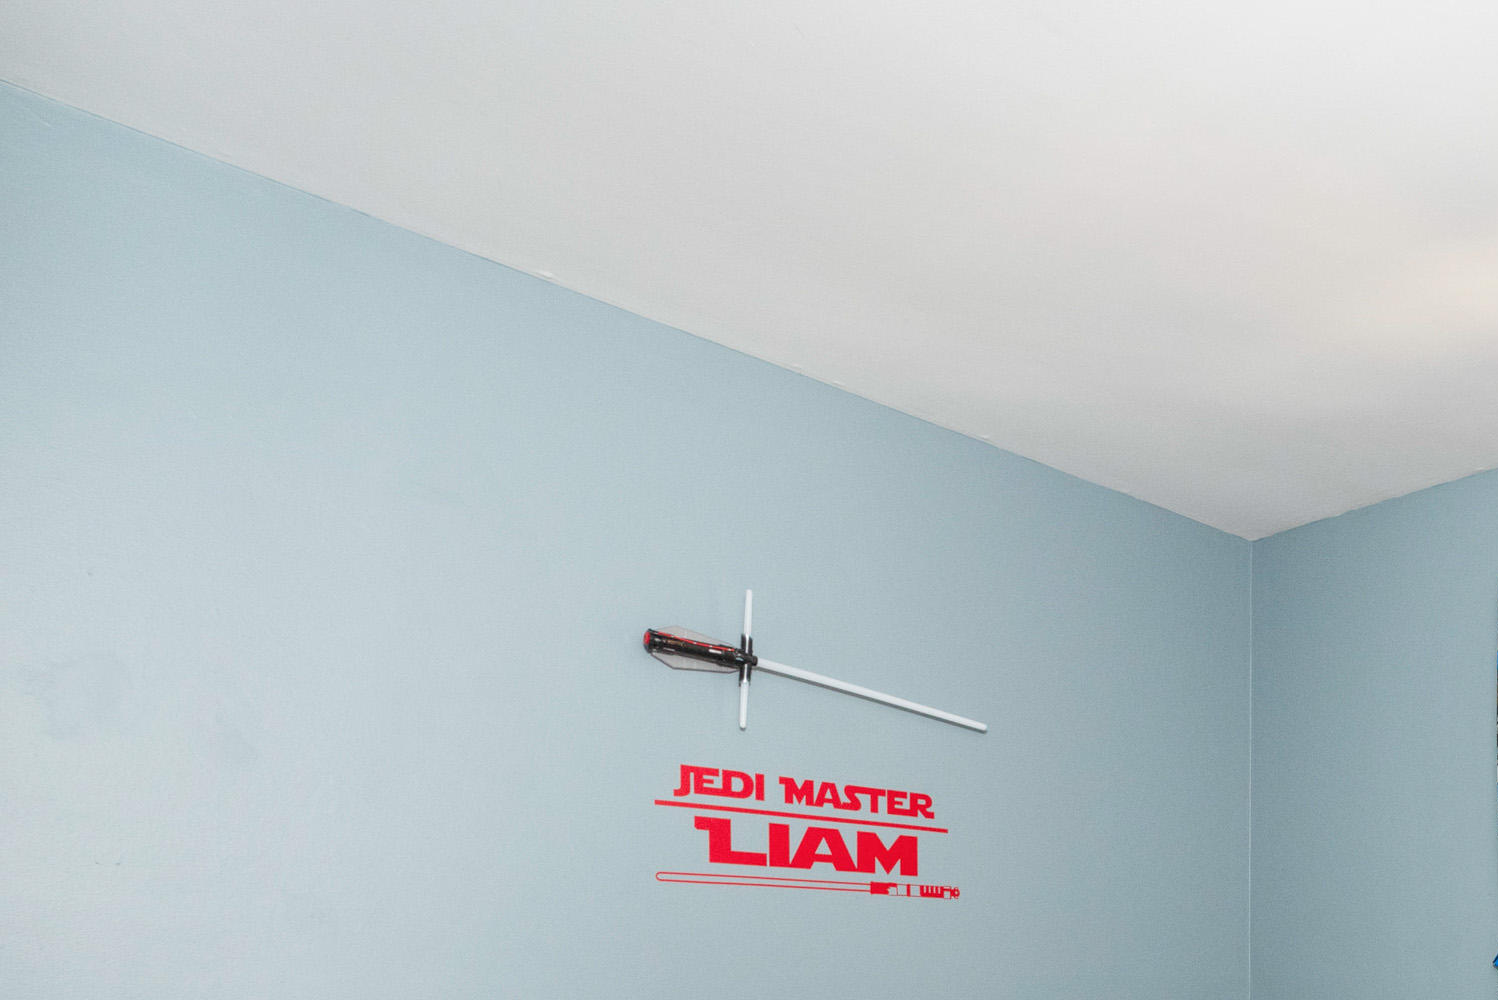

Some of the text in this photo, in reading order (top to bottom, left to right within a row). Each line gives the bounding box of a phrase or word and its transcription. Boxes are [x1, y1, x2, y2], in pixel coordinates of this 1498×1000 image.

[673, 764, 936, 820] JEDI MASTER
[694, 815, 919, 877] LIAM
